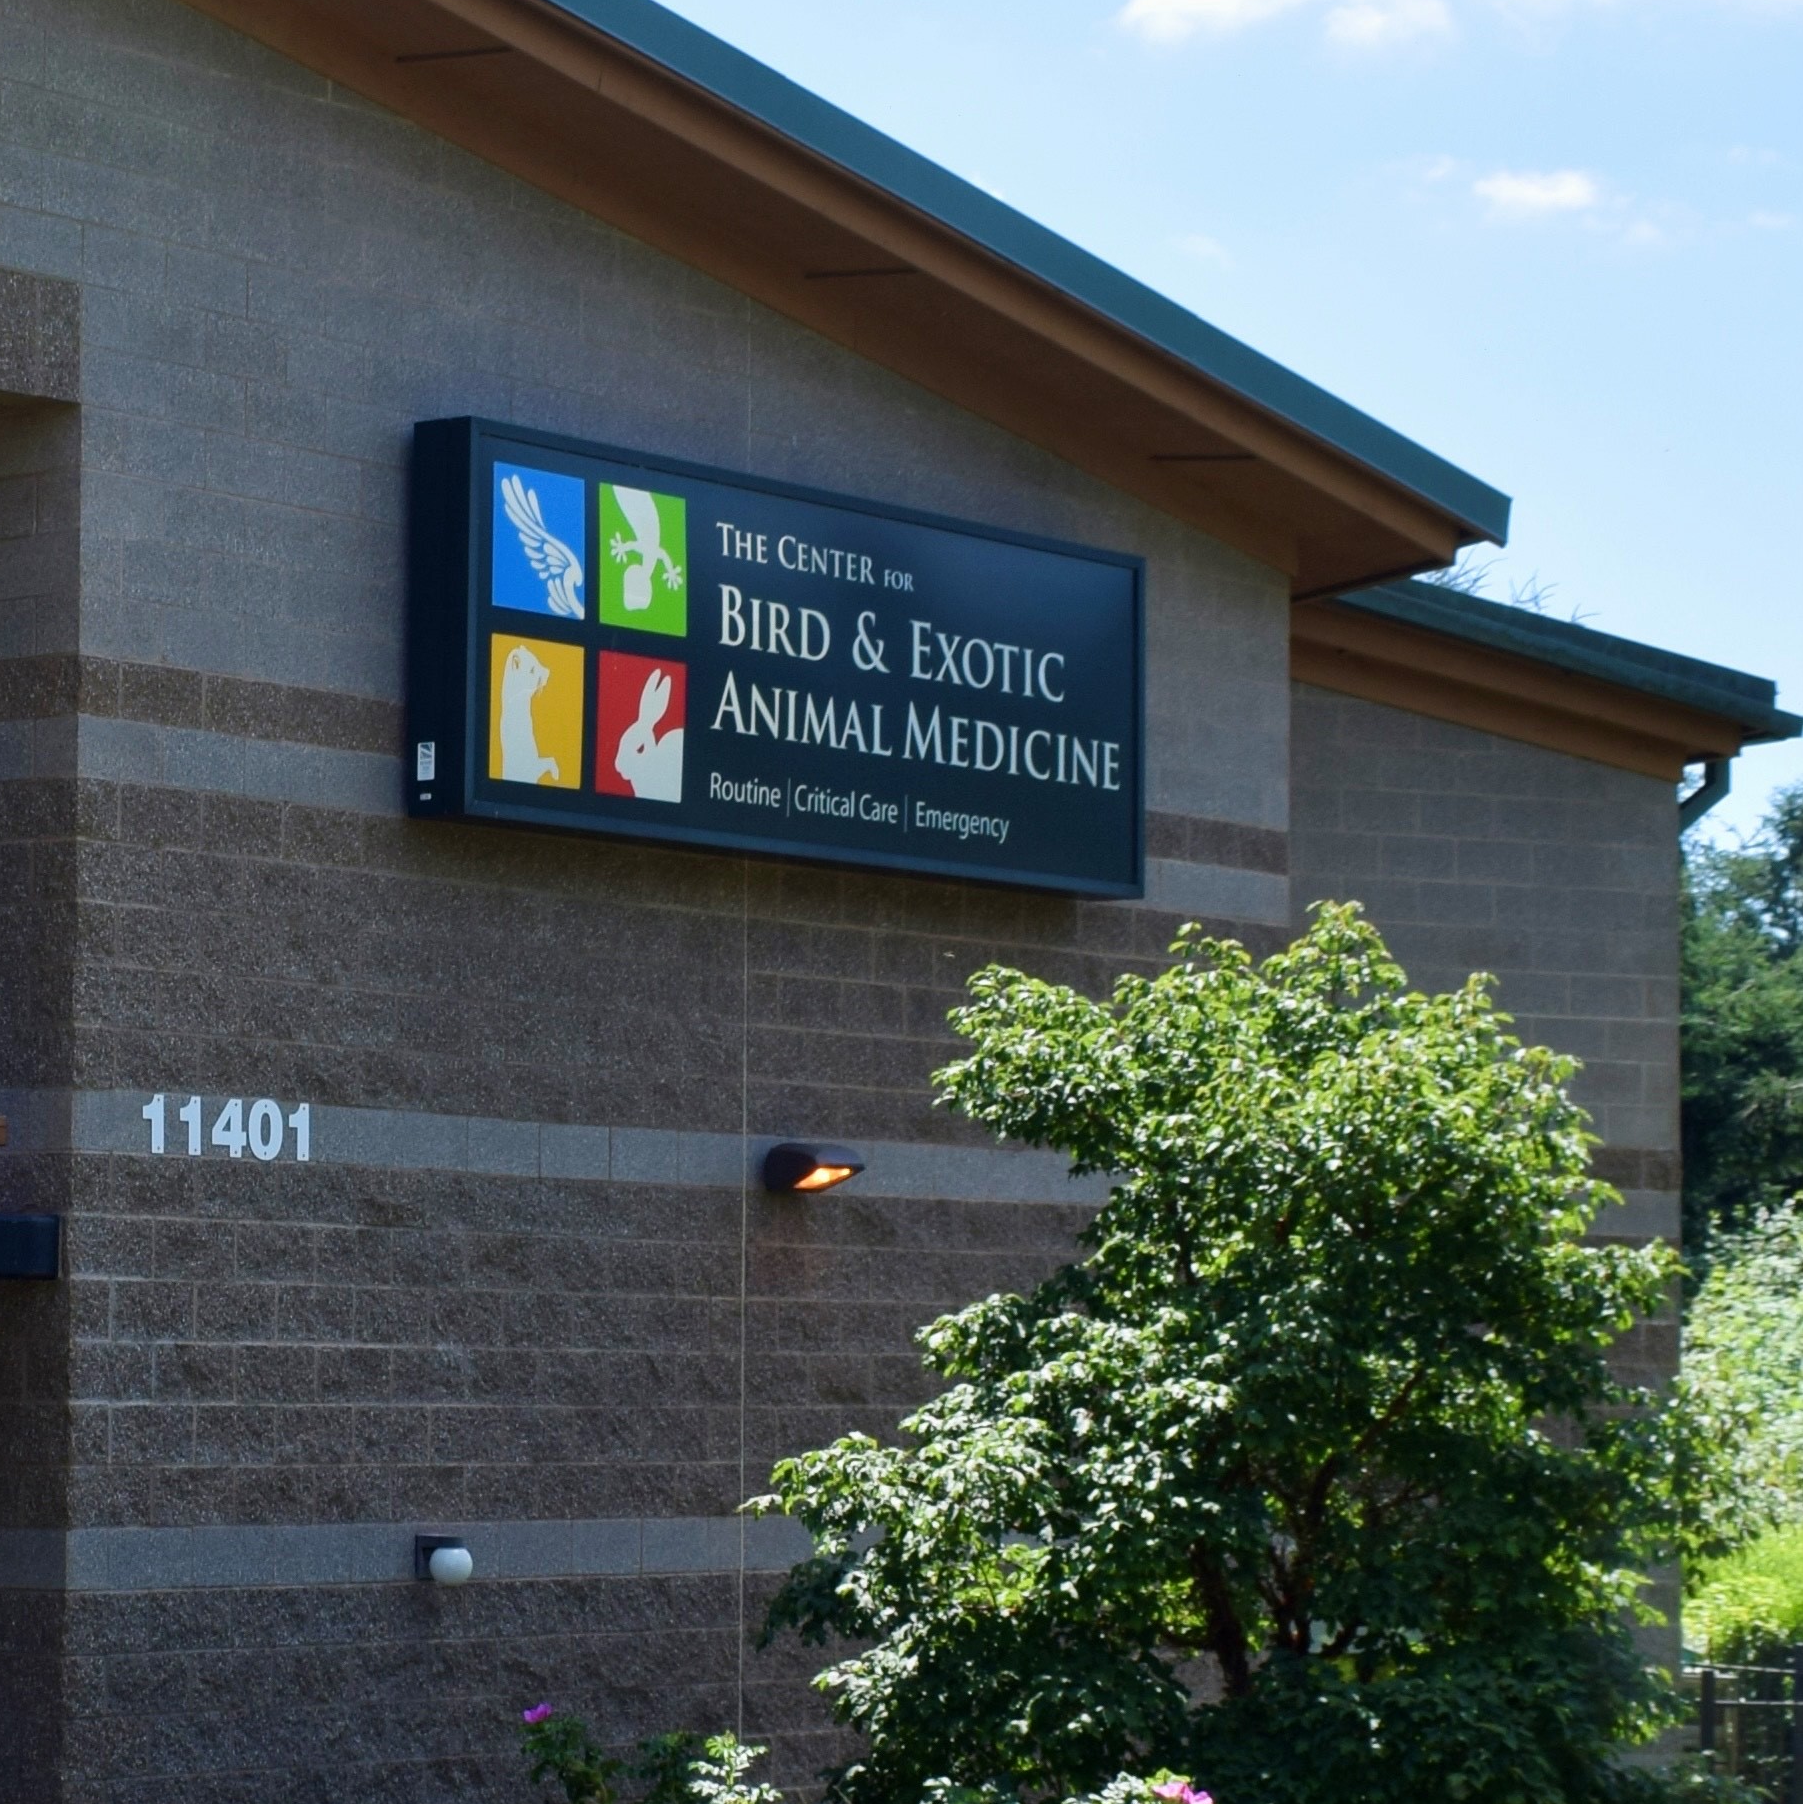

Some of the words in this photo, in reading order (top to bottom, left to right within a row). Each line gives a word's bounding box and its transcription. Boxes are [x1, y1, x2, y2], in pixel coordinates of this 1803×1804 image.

[884, 568, 914, 592] FOR
[852, 610, 890, 674] &
[709, 772, 781, 808] Routine
[794, 784, 855, 821] Critical
[859, 793, 899, 824] Care
[915, 801, 1010, 845] Emergency
[142, 1093, 311, 1162] 11401
